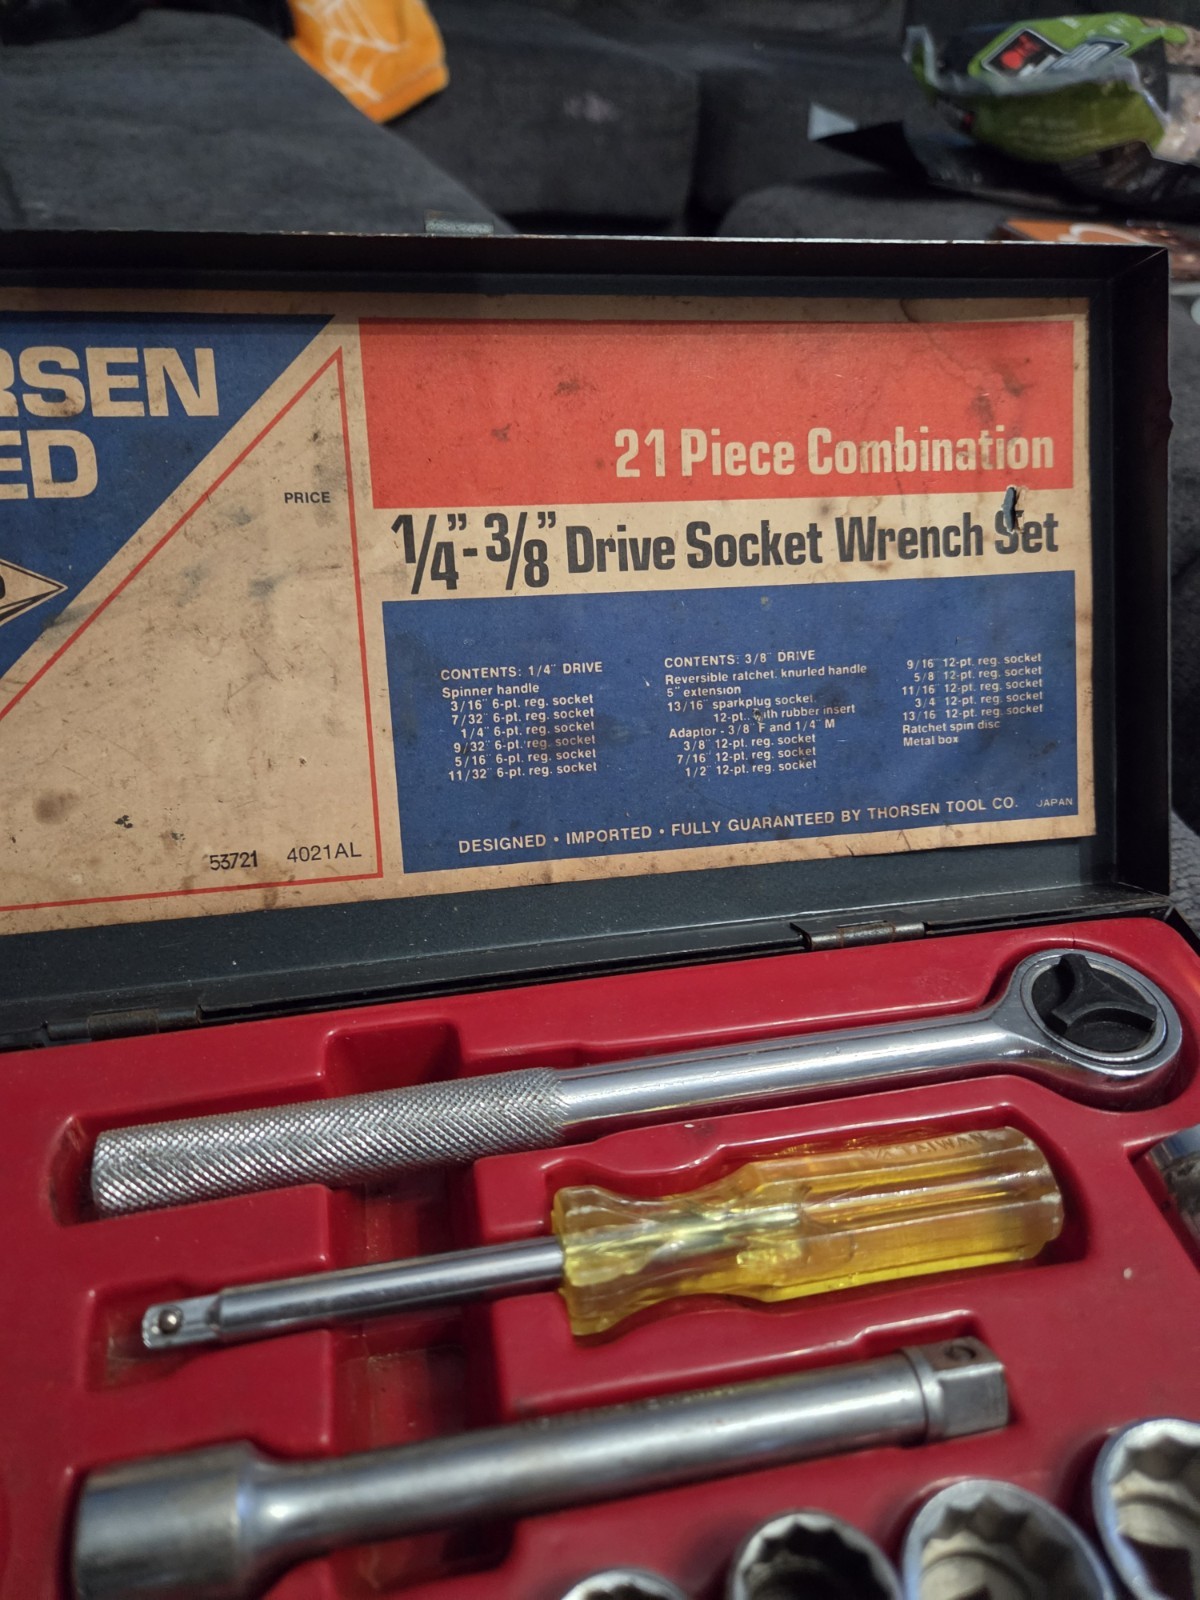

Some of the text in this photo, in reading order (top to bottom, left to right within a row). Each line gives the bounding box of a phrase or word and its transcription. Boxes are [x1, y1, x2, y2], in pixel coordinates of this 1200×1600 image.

[614, 424, 1055, 478] 21 Piece Combination
[284, 491, 331, 503] PRICE
[565, 524, 676, 574] Drive
[685, 517, 824, 569] Socket
[834, 511, 985, 563] Wrench
[993, 510, 1059, 556] Set
[664, 654, 740, 668] CONTENTS:
[777, 650, 816, 662] DRIVE
[943, 657, 975, 668] 12-pt.
[978, 657, 1000, 667] reg.
[1004, 653, 1042, 664] socket
[440, 666, 522, 680] CONTENTS:
[562, 661, 603, 674] DRIVE
[665, 671, 729, 685] Reversible
[781, 666, 825, 678] knurled
[828, 664, 867, 675] handle
[944, 670, 975, 681] 12-pt.
[979, 669, 1000, 679] reg.
[1004, 666, 1042, 676] socket
[442, 683, 540, 699] Spinner handle
[683, 686, 741, 697] extension
[945, 683, 976, 693] 12-pt.
[980, 682, 1002, 692] reg.
[1006, 679, 1043, 689] socket
[492, 699, 520, 711] 6-pt.
[524, 697, 548, 708] reg.
[552, 694, 594, 704] socket
[712, 697, 771, 710] sparkplug
[945, 696, 976, 706] 12-pt.
[981, 695, 1003, 705] reg.
[1006, 691, 1043, 702] socket
[493, 712, 521, 724] 6-pt.
[525, 711, 549, 722] reg.
[553, 707, 594, 719] socket
[753, 708, 778, 721] ith
[781, 707, 820, 718] rubber
[823, 705, 856, 714] insert
[945, 709, 977, 719] 12-pt.
[981, 708, 1003, 718] reg.
[1006, 704, 1043, 715] socket
[494, 727, 522, 738] 6-pt.
[526, 725, 550, 737] reg.
[554, 721, 595, 733] socket
[669, 728, 716, 739] Adaptor
[759, 723, 765, 732] F
[769, 722, 791, 732] and
[824, 719, 835, 728] M
[902, 720, 1000, 734] Ratchet spin disc
[494, 740, 523, 751] 6-pt.
[526, 739, 550, 750] reg.
[555, 735, 596, 746] socket
[715, 738, 747, 749] 12-pt.
[751, 737, 774, 747] reg.
[777, 734, 816, 745] socket
[903, 735, 959, 746] Metal box
[496, 753, 524, 765] 6-pt.
[527, 752, 551, 764] reg.
[556, 749, 596, 760] socket
[715, 751, 748, 763] 12-pt.
[752, 750, 774, 761] reg.
[778, 747, 816, 758] socket
[496, 767, 525, 779] 6-pt.
[529, 766, 552, 777] reg.
[556, 762, 597, 774] socket
[716, 764, 749, 776] 12-pt.
[752, 763, 775, 774] reg.
[778, 760, 817, 770] socket
[1036, 798, 1073, 807] JAPAN
[458, 797, 1018, 854] DESIGNED IMPORTED FULLY GUARANTEED BY THORSEN TOOL CO.
[287, 842, 362, 862] 4021AL
[209, 850, 258, 871] 53721
